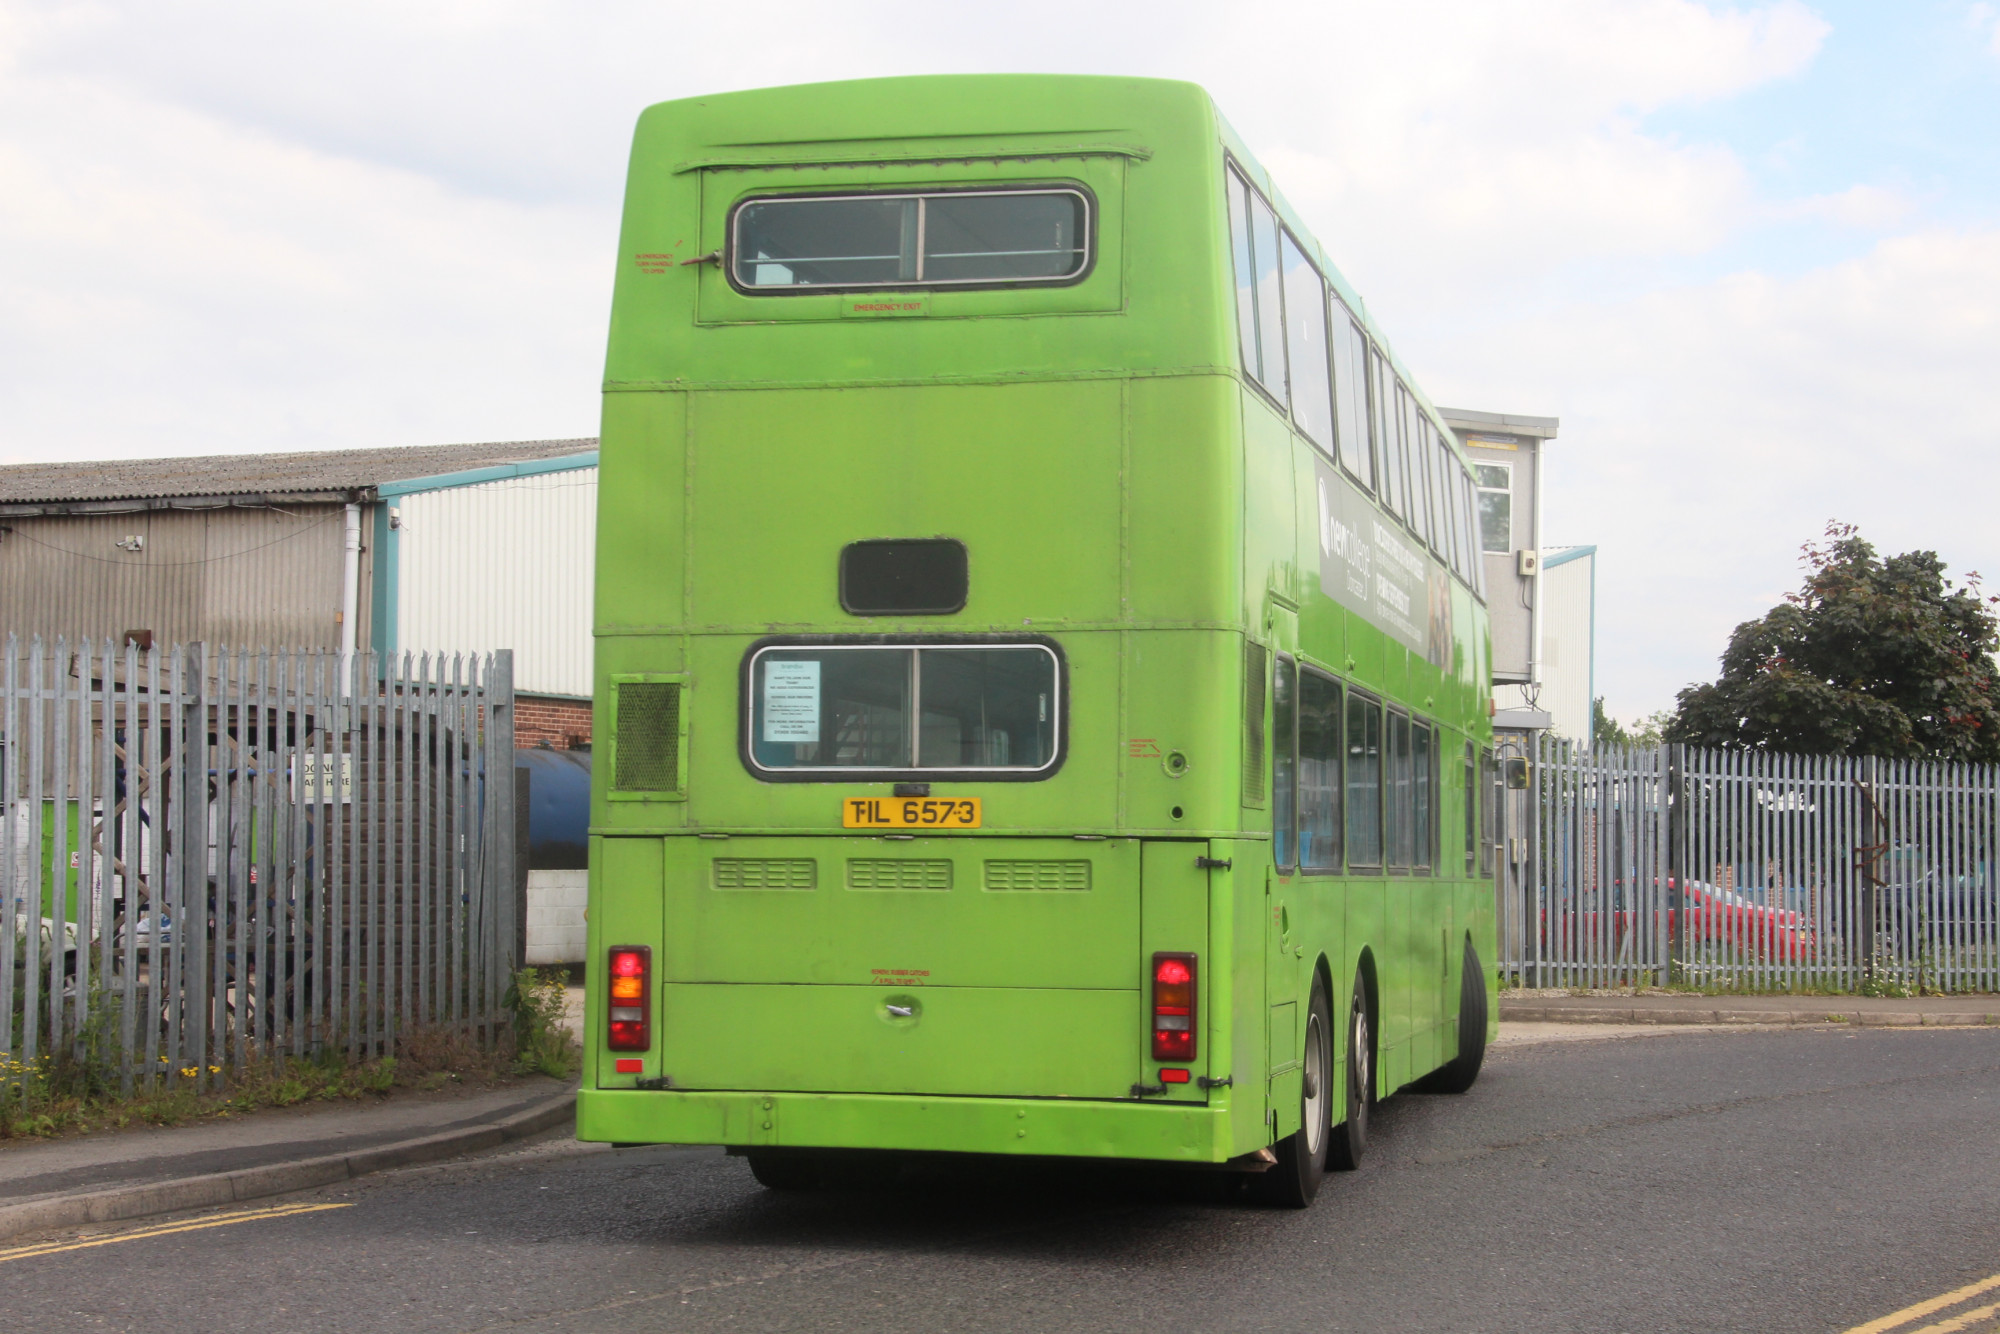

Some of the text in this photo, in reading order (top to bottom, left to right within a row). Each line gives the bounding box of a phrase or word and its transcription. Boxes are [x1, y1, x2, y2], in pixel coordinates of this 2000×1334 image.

[854, 302, 921, 312] EMERGENCY EXIT
[326, 777, 349, 786] HRE
[851, 801, 974, 824] TIL 6573
